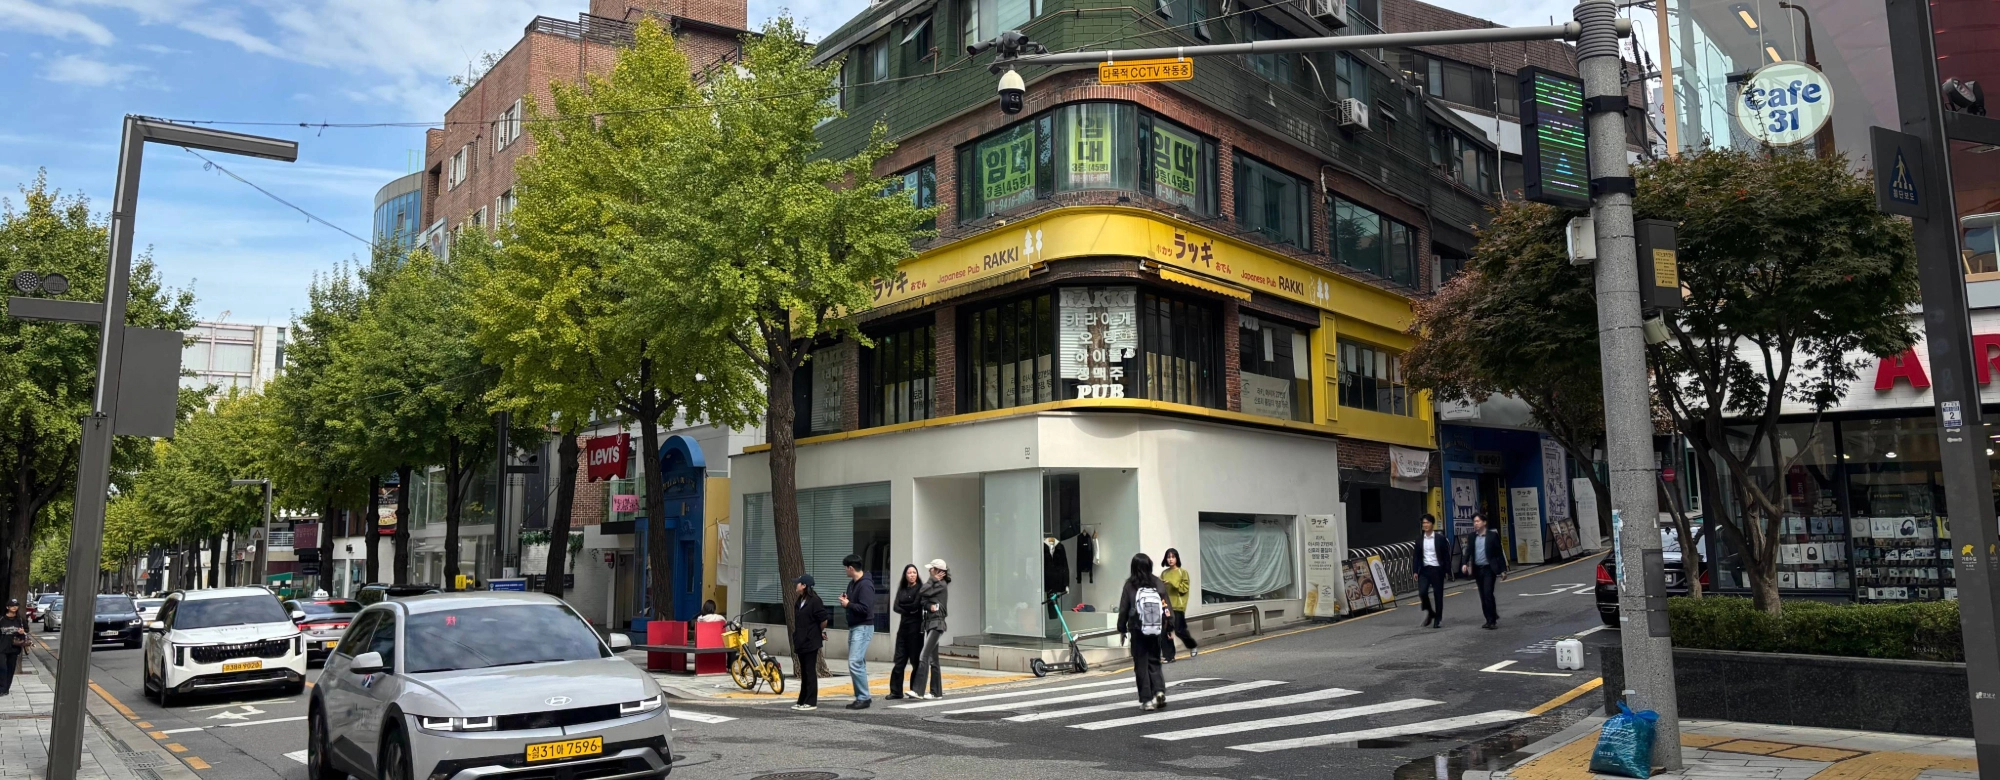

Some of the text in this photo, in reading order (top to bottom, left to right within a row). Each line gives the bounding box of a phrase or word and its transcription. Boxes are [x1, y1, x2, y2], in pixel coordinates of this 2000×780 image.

[1103, 64, 1189, 80] 다목적 CCTV 작동중
[1767, 106, 1800, 133] 31
[985, 137, 1033, 186] 임대
[1153, 131, 1194, 179] 임대
[937, 246, 1019, 284] Japanese Pub RAKKI
[1240, 269, 1305, 296] Japanese Pub RAKKI
[1059, 290, 1137, 308] RAKKI
[1077, 366, 1124, 381] 생맥주
[1077, 383, 1125, 400] PUB
[566, 740, 598, 755] 7596
